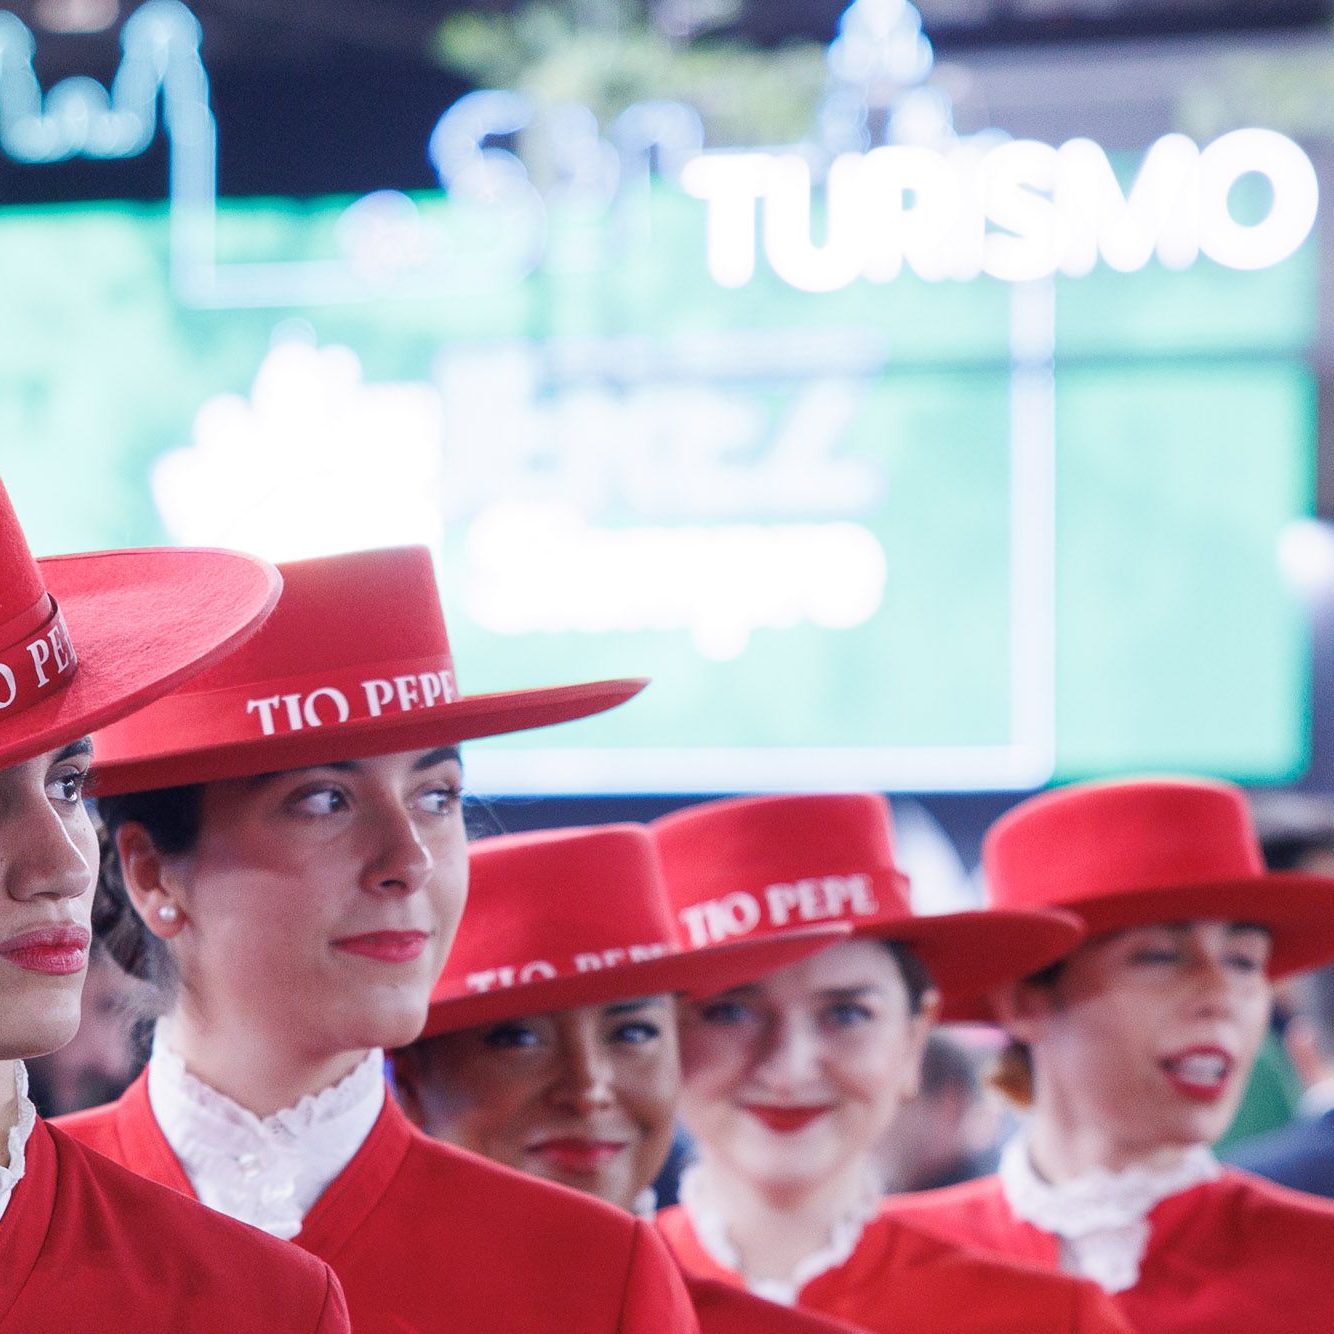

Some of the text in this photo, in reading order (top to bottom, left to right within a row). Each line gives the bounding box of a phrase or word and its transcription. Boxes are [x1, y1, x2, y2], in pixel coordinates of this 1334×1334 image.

[681, 127, 1320, 293] TURISMO
[26, 613, 78, 689] PE
[246, 669, 454, 736] TIO PEPE
[678, 890, 761, 949] TIO
